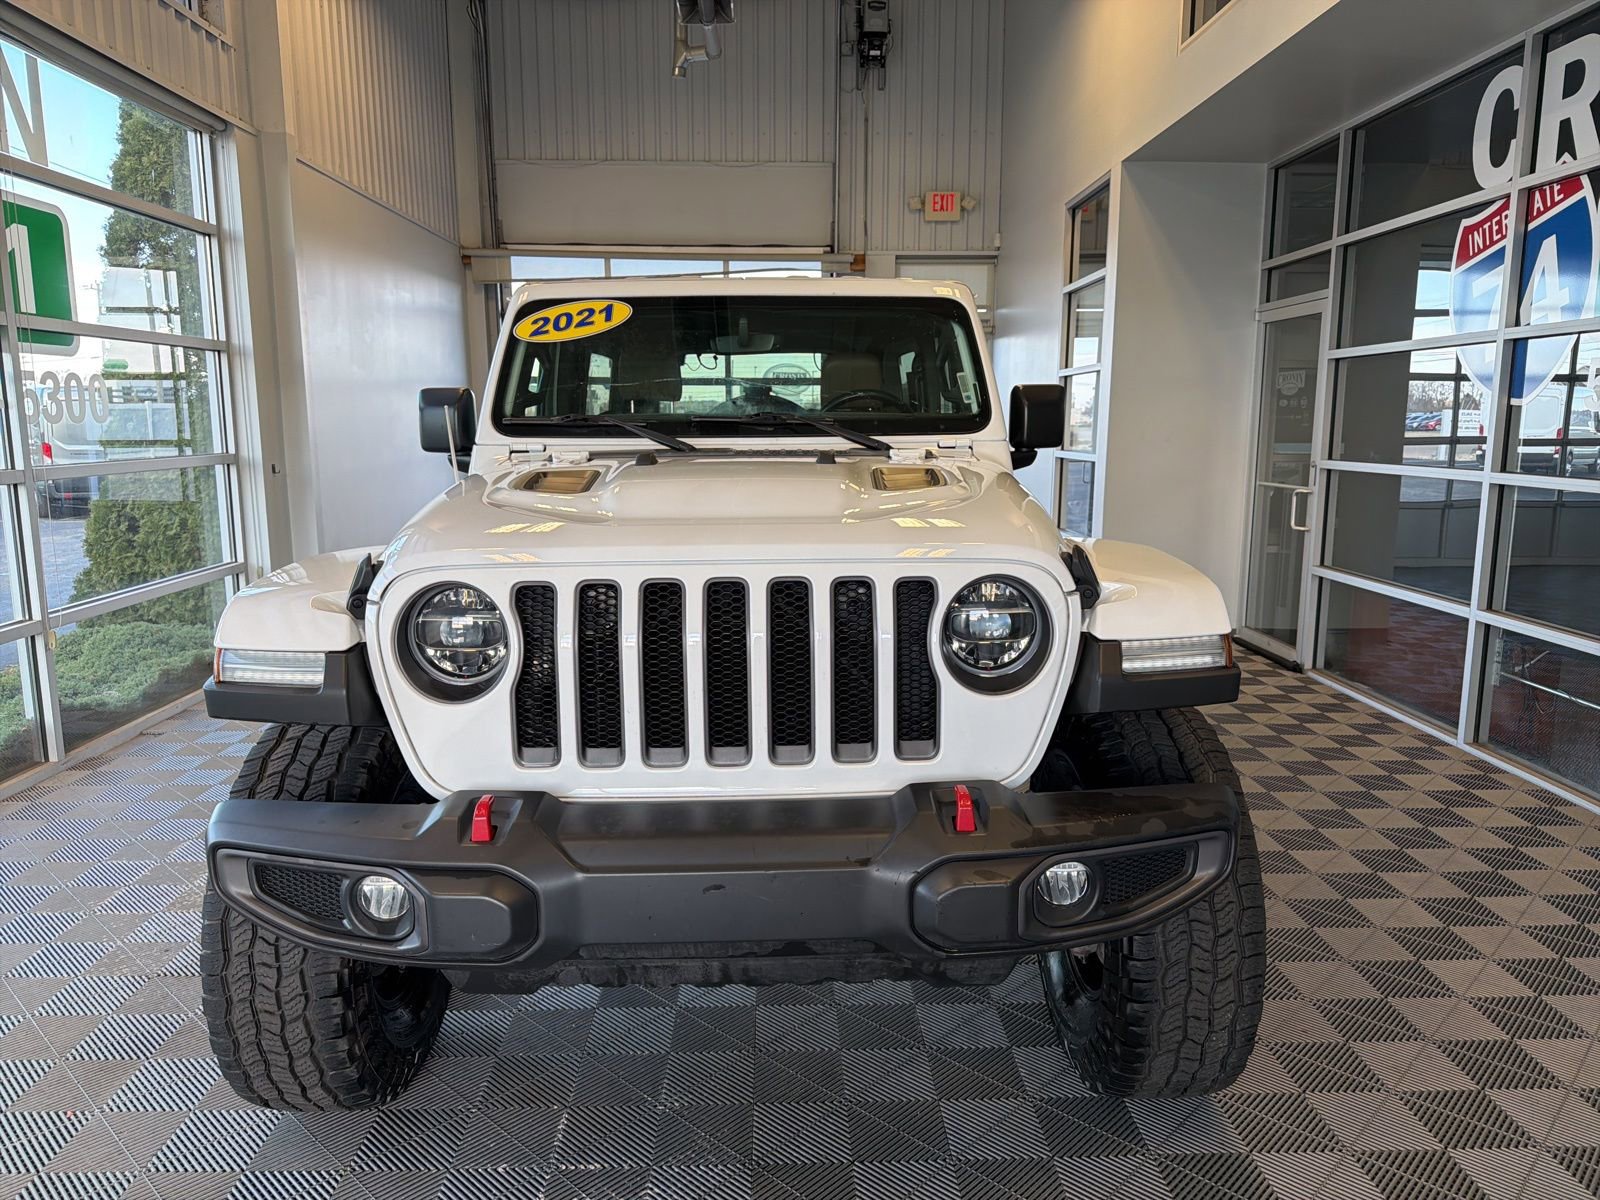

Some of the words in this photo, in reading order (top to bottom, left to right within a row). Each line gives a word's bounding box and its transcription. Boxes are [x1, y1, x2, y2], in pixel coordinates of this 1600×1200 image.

[932, 192, 955, 212] EXIT
[1468, 182, 1564, 257] INTERATE
[528, 303, 614, 338] 2021
